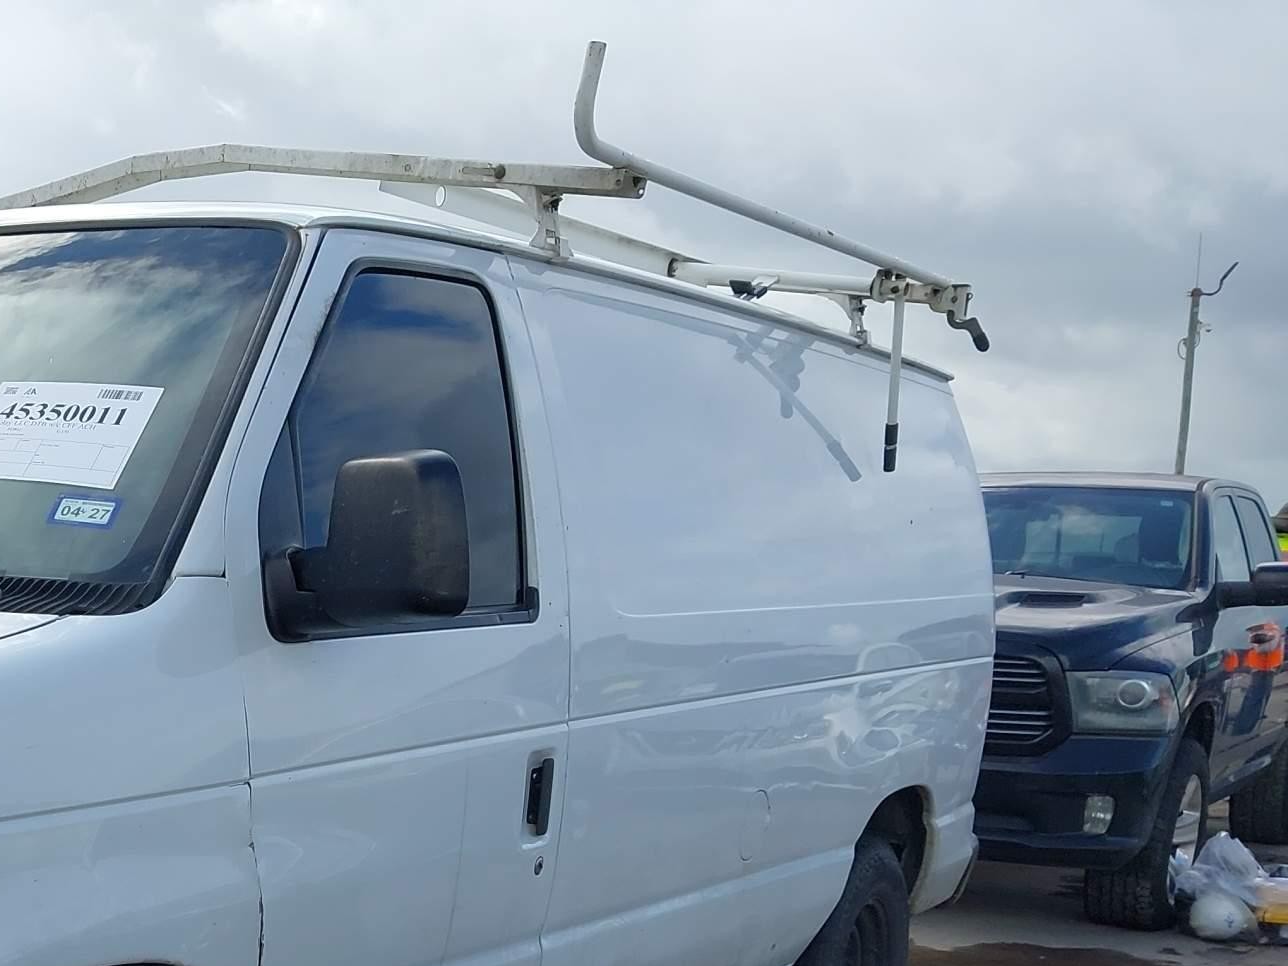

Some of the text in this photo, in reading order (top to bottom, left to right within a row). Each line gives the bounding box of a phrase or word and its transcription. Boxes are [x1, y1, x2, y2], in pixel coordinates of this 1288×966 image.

[0, 402, 129, 426] 45350011
[60, 505, 112, 520] 04 27
